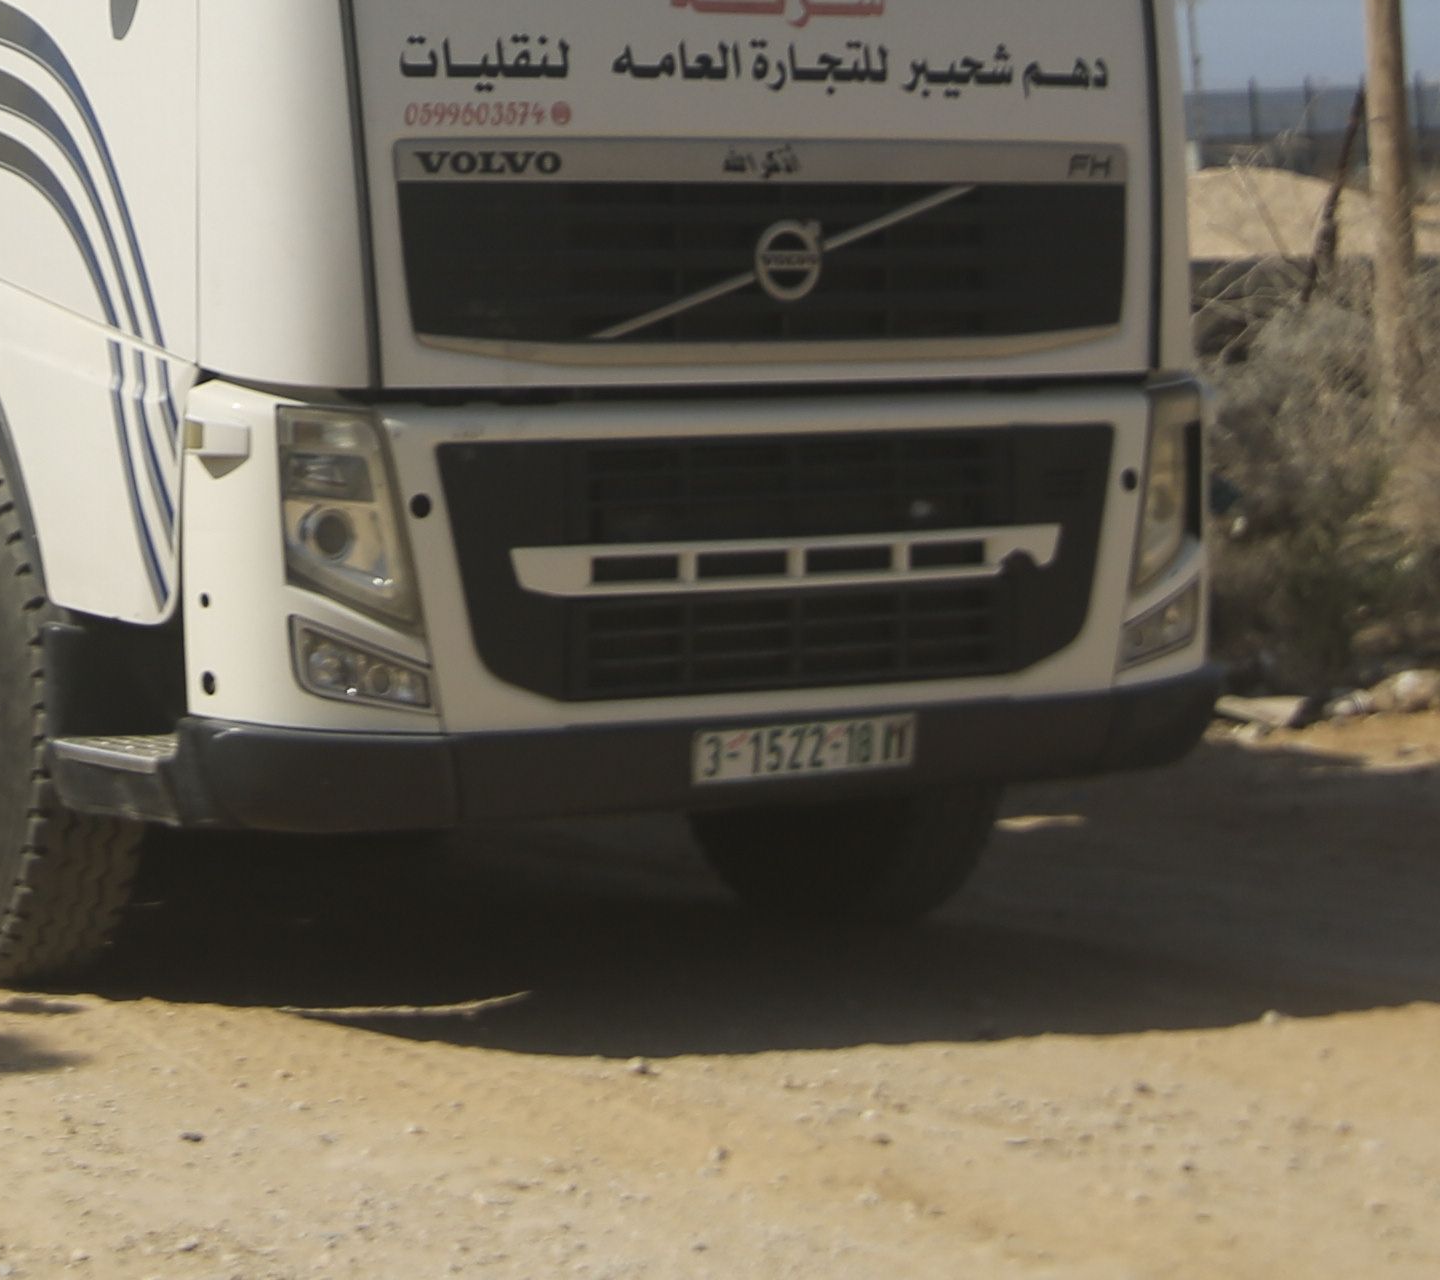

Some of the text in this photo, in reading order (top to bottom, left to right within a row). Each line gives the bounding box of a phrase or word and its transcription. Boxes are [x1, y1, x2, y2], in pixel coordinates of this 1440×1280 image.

[398, 33, 570, 93] لنقليات
[611, 39, 741, 81] العامه
[751, 38, 889, 97] للتجارة
[901, 41, 1014, 99] شحيبر
[413, 149, 563, 176] VOLVO
[1066, 152, 1111, 179] FH
